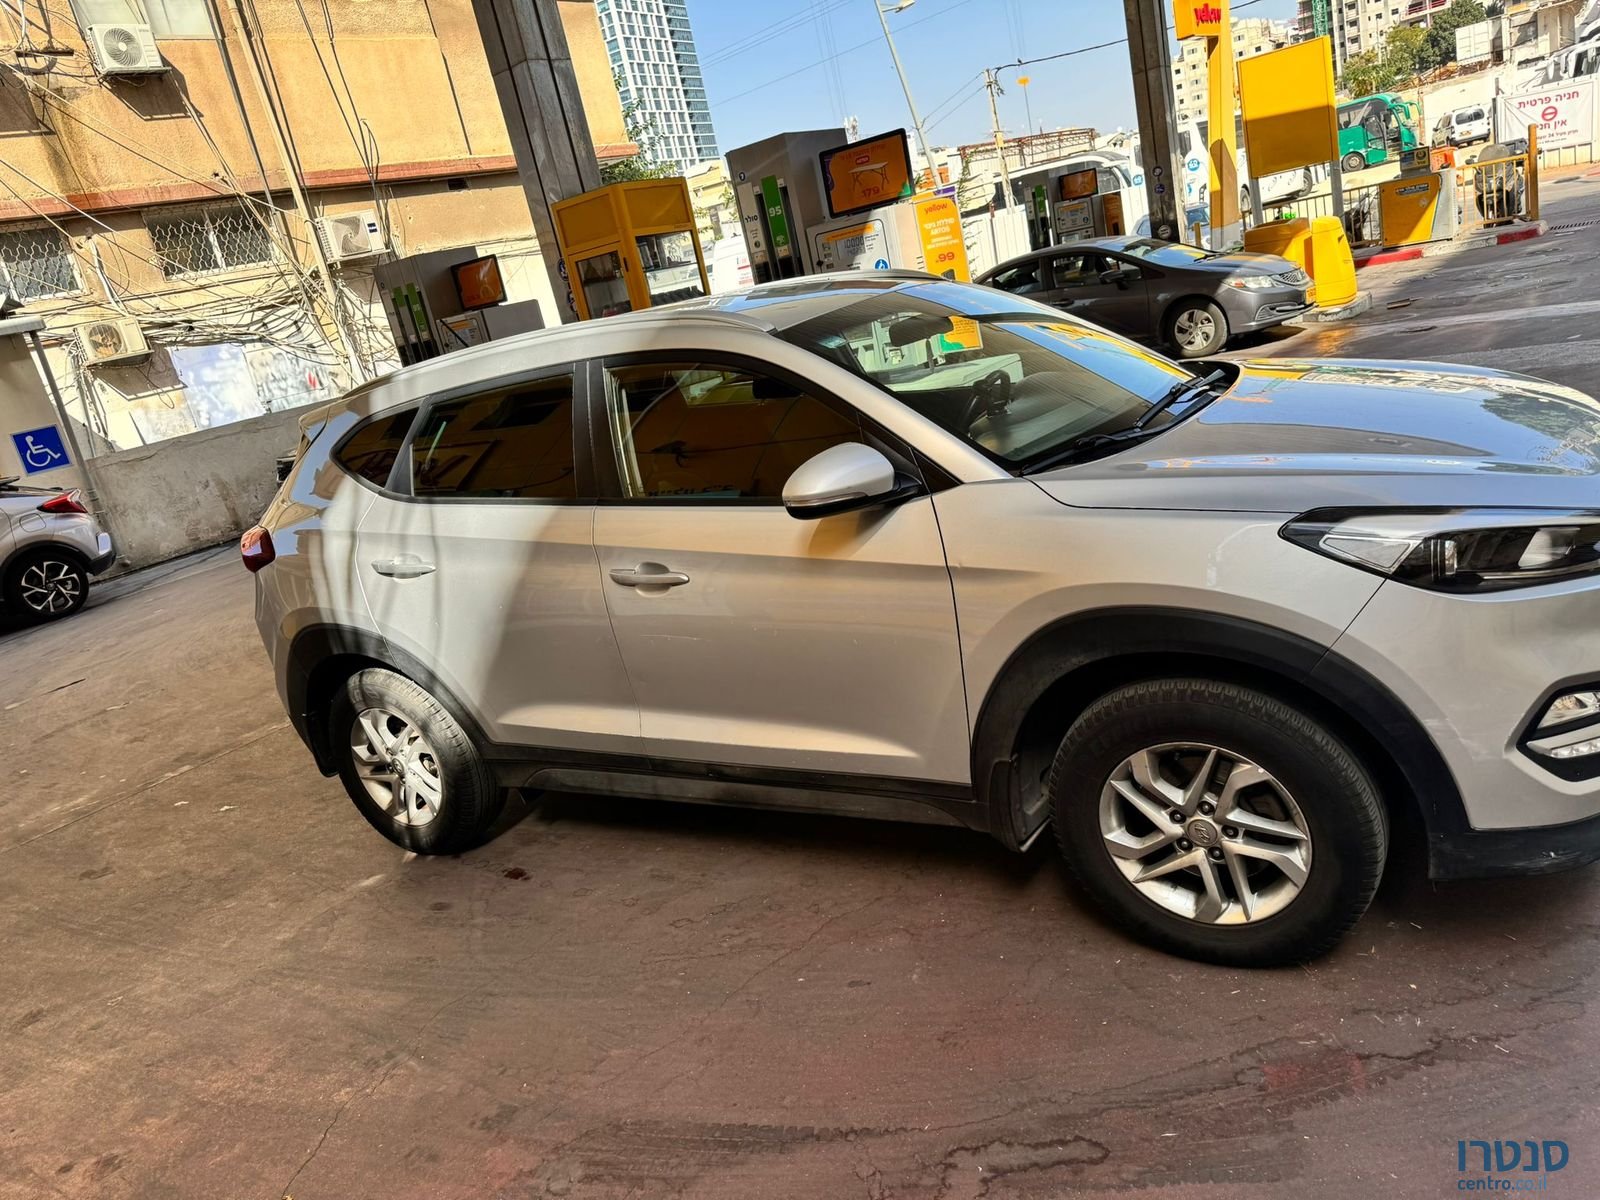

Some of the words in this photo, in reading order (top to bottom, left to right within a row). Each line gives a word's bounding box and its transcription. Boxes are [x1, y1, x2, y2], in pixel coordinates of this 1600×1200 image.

[1555, 90, 1579, 102] חניה
[1516, 96, 1552, 110] פרטית
[1554, 119, 1567, 130] אין
[768, 206, 782, 217] 95
[924, 203, 948, 214] yellow
[744, 214, 758, 223] סולר
